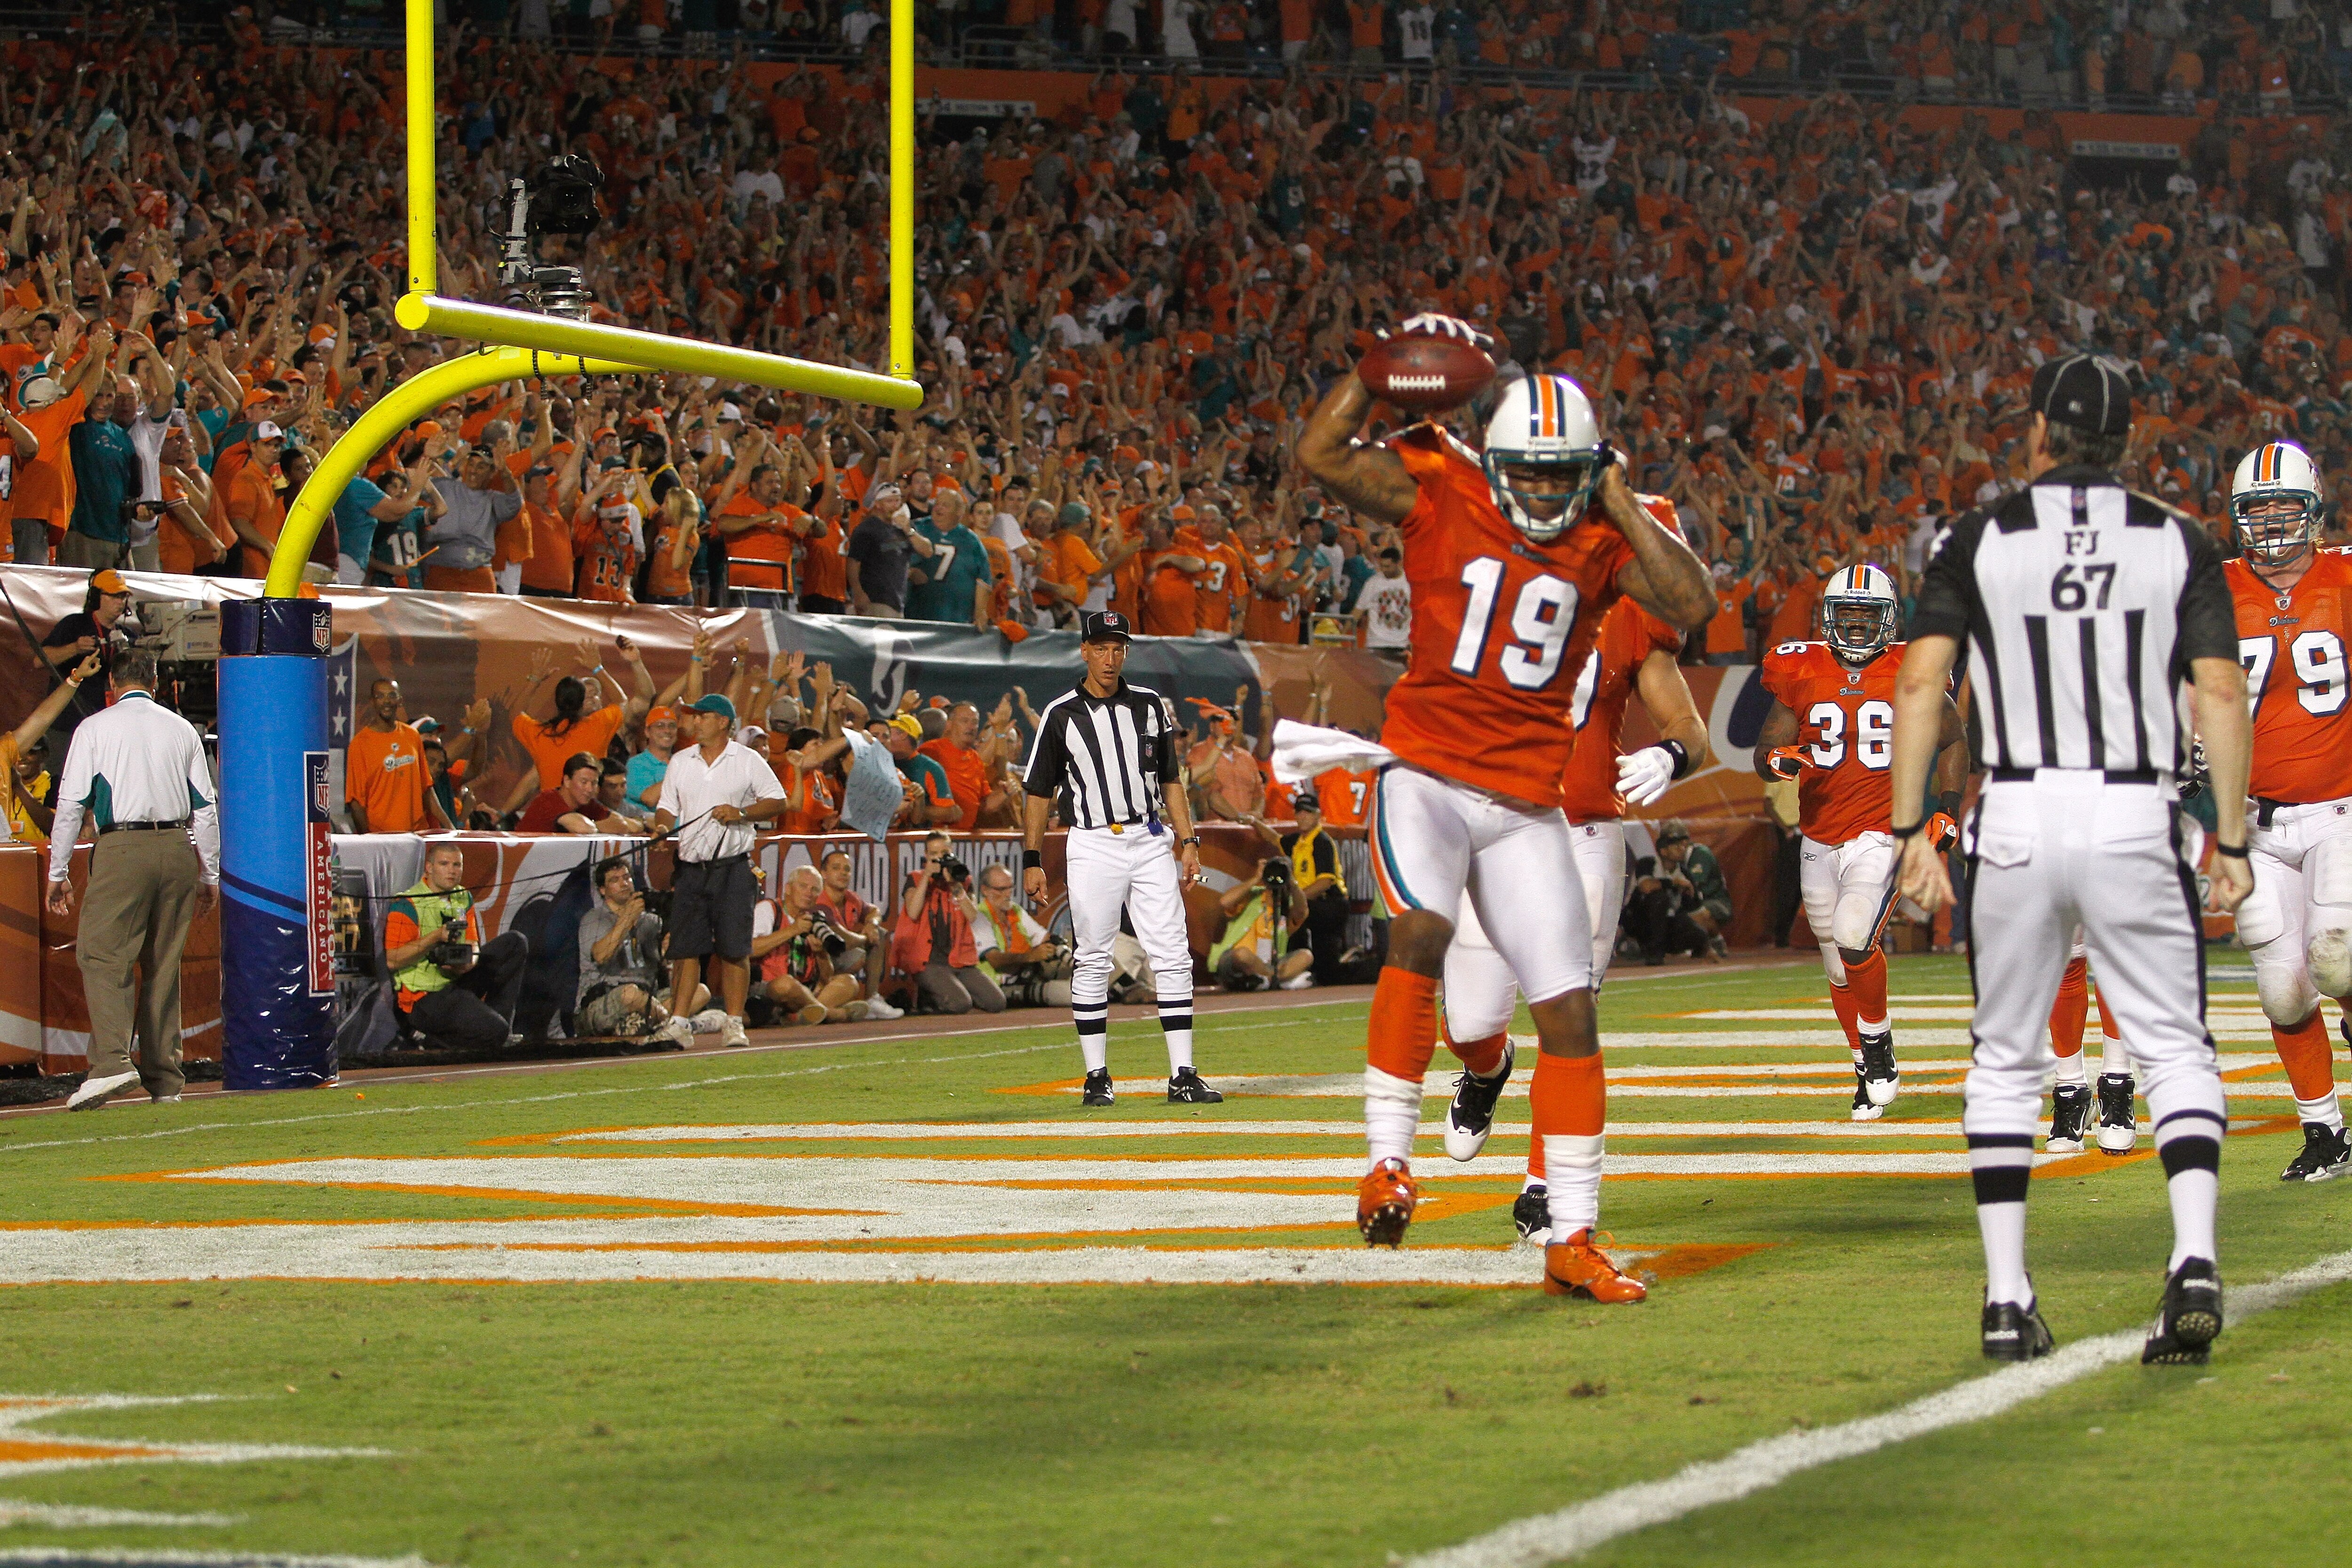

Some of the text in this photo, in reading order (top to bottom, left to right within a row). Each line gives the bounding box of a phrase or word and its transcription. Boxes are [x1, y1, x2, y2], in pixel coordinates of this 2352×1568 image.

[387, 532, 418, 567] 19
[934, 543, 956, 581] 7
[2064, 531, 2099, 555] FJ
[2051, 563, 2116, 612] 67
[1450, 554, 1580, 693] 19
[2238, 629, 2352, 724] 79
[1810, 699, 1894, 772] 36
[318, 784, 329, 808] NF
[1349, 781, 1367, 815] 7
[317, 840, 327, 963] AMERICANO
